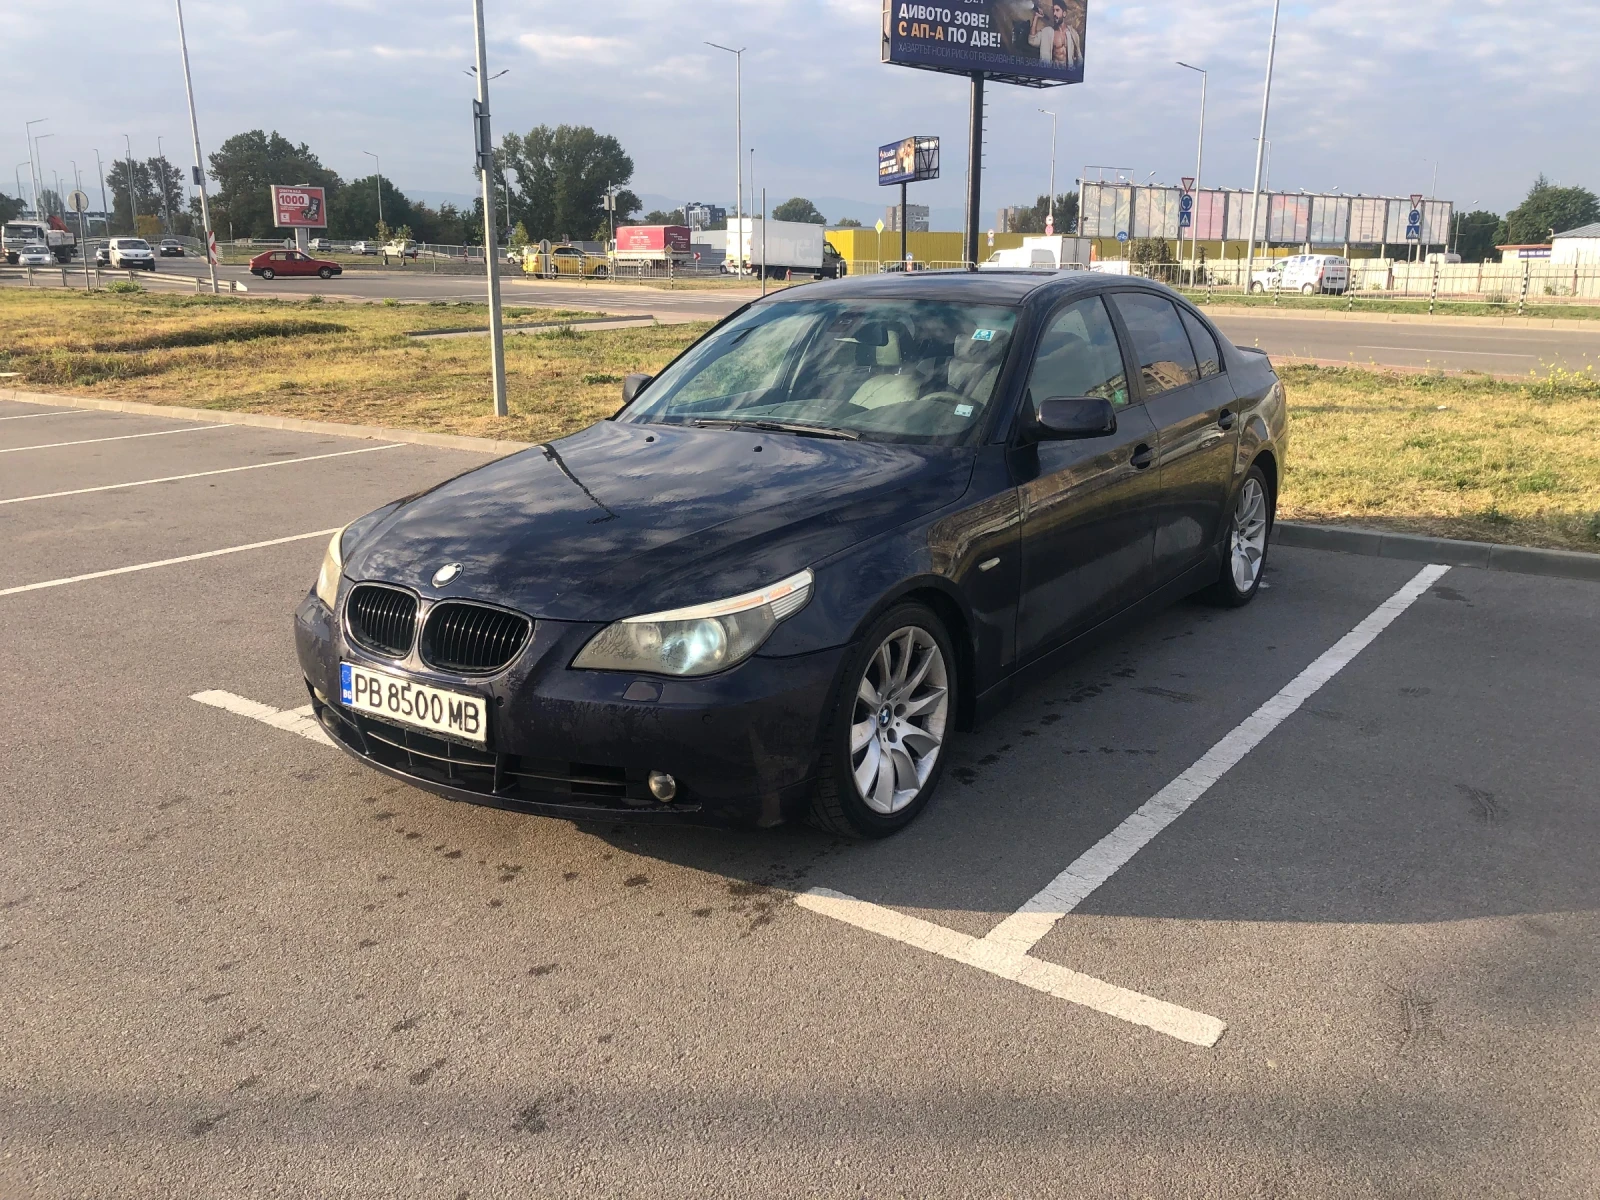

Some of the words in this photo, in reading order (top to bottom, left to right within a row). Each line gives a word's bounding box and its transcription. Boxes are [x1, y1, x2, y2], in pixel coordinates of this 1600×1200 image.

[898, 3, 952, 23] ДИВОТО
[954, 10, 990, 28] ЗОВЕ!
[898, 21, 908, 37] С
[911, 22, 945, 41] АП-А
[947, 26, 967, 44] ПО
[970, 30, 1001, 48] ДВЕ!
[898, 41, 931, 55] ХАЗАРТЪТ
[951, 48, 969, 60] РИСК
[969, 50, 978, 60] ОТ
[979, 51, 1015, 65] РАЗВИВАНЕ
[1015, 56, 1025, 66] НА
[280, 194, 305, 205] 1000
[343, 689, 352, 699] BG
[355, 673, 382, 708] PB
[388, 682, 444, 724] 8500
[448, 697, 480, 734] MB
